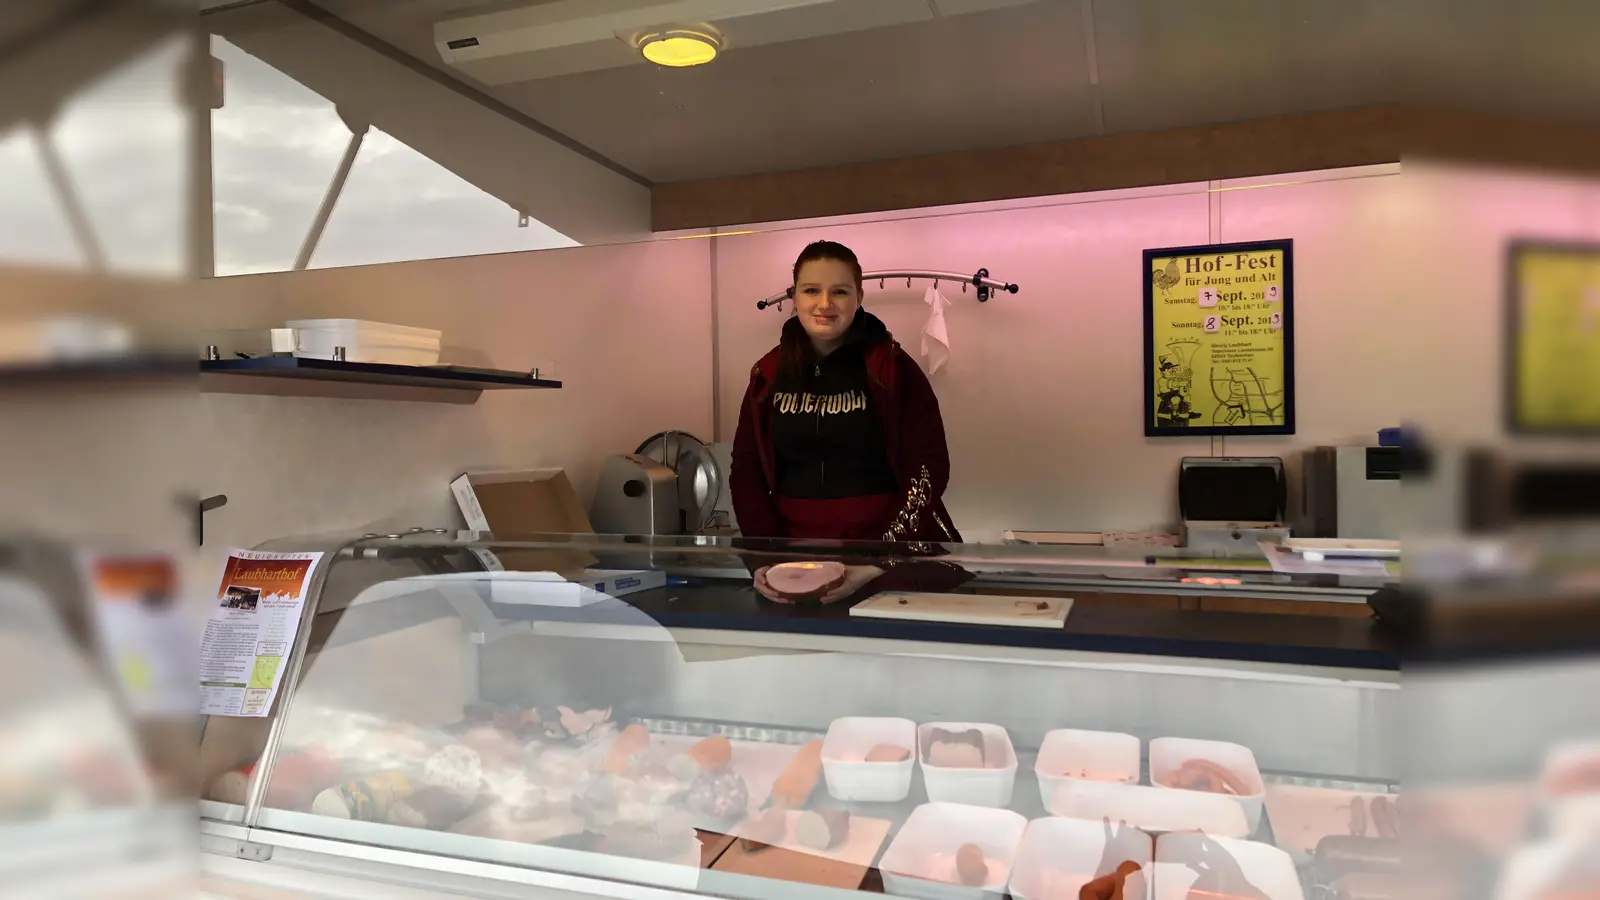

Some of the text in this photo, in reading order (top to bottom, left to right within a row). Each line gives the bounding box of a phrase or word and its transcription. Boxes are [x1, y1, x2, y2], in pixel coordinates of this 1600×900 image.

[1184, 254, 1277, 273] Hof-Fest
[1185, 272, 1276, 286] für Jung und Alt
[1204, 291, 1213, 301] 7
[1216, 289, 1247, 304] Sept.
[1206, 316, 1216, 330] 8
[1220, 314, 1254, 329] Sept.
[238, 551, 310, 559] NEUIGKEITEN
[234, 567, 302, 580] Laubharthof
